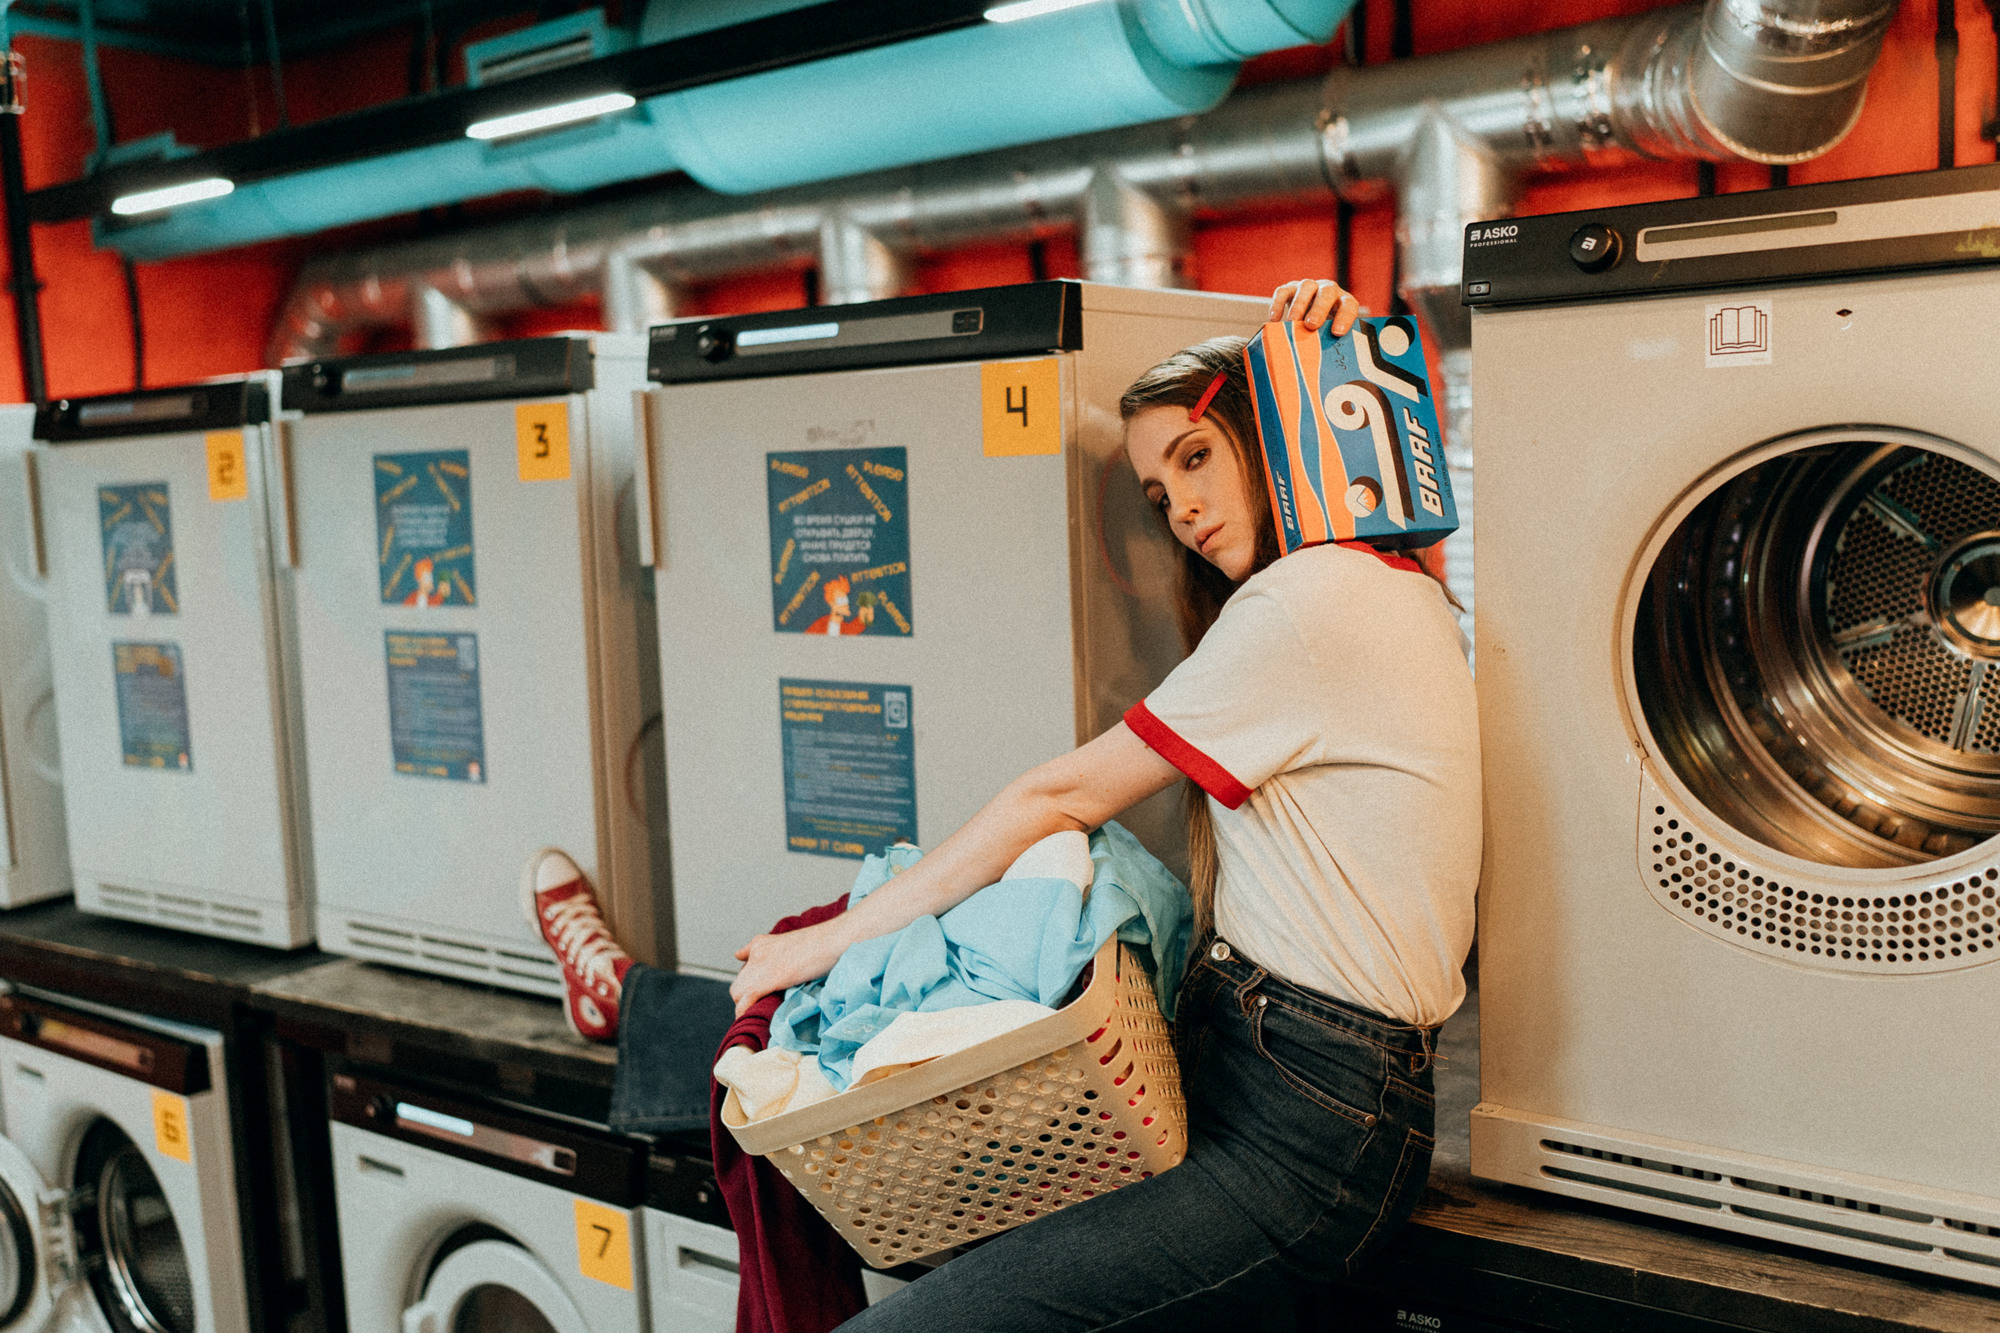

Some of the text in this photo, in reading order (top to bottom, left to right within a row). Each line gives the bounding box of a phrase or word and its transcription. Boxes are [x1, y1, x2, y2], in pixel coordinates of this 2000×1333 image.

[1470, 238, 1517, 248] PROFESSIONAL
[1483, 225, 1518, 240] ASKO
[1006, 386, 1028, 427] 4
[533, 423, 549, 458] 3
[218, 451, 234, 485] 2
[862, 460, 904, 482] PLEASE
[777, 478, 831, 514] ATTENTION
[845, 463, 893, 523] ATTENTION
[806, 514, 833, 526] ВРЕМЯ
[833, 514, 864, 526] СУШКИ
[865, 514, 876, 525] НЕ
[794, 527, 841, 538] ОТКРЫВАТЬ
[802, 552, 870, 564] СНОВА ПЛАТИТЬ
[850, 561, 907, 584] ATTENTION
[779, 570, 821, 626] ATTENTION
[591, 1223, 612, 1258] 7
[1409, 1313, 1441, 1328] ASKO
